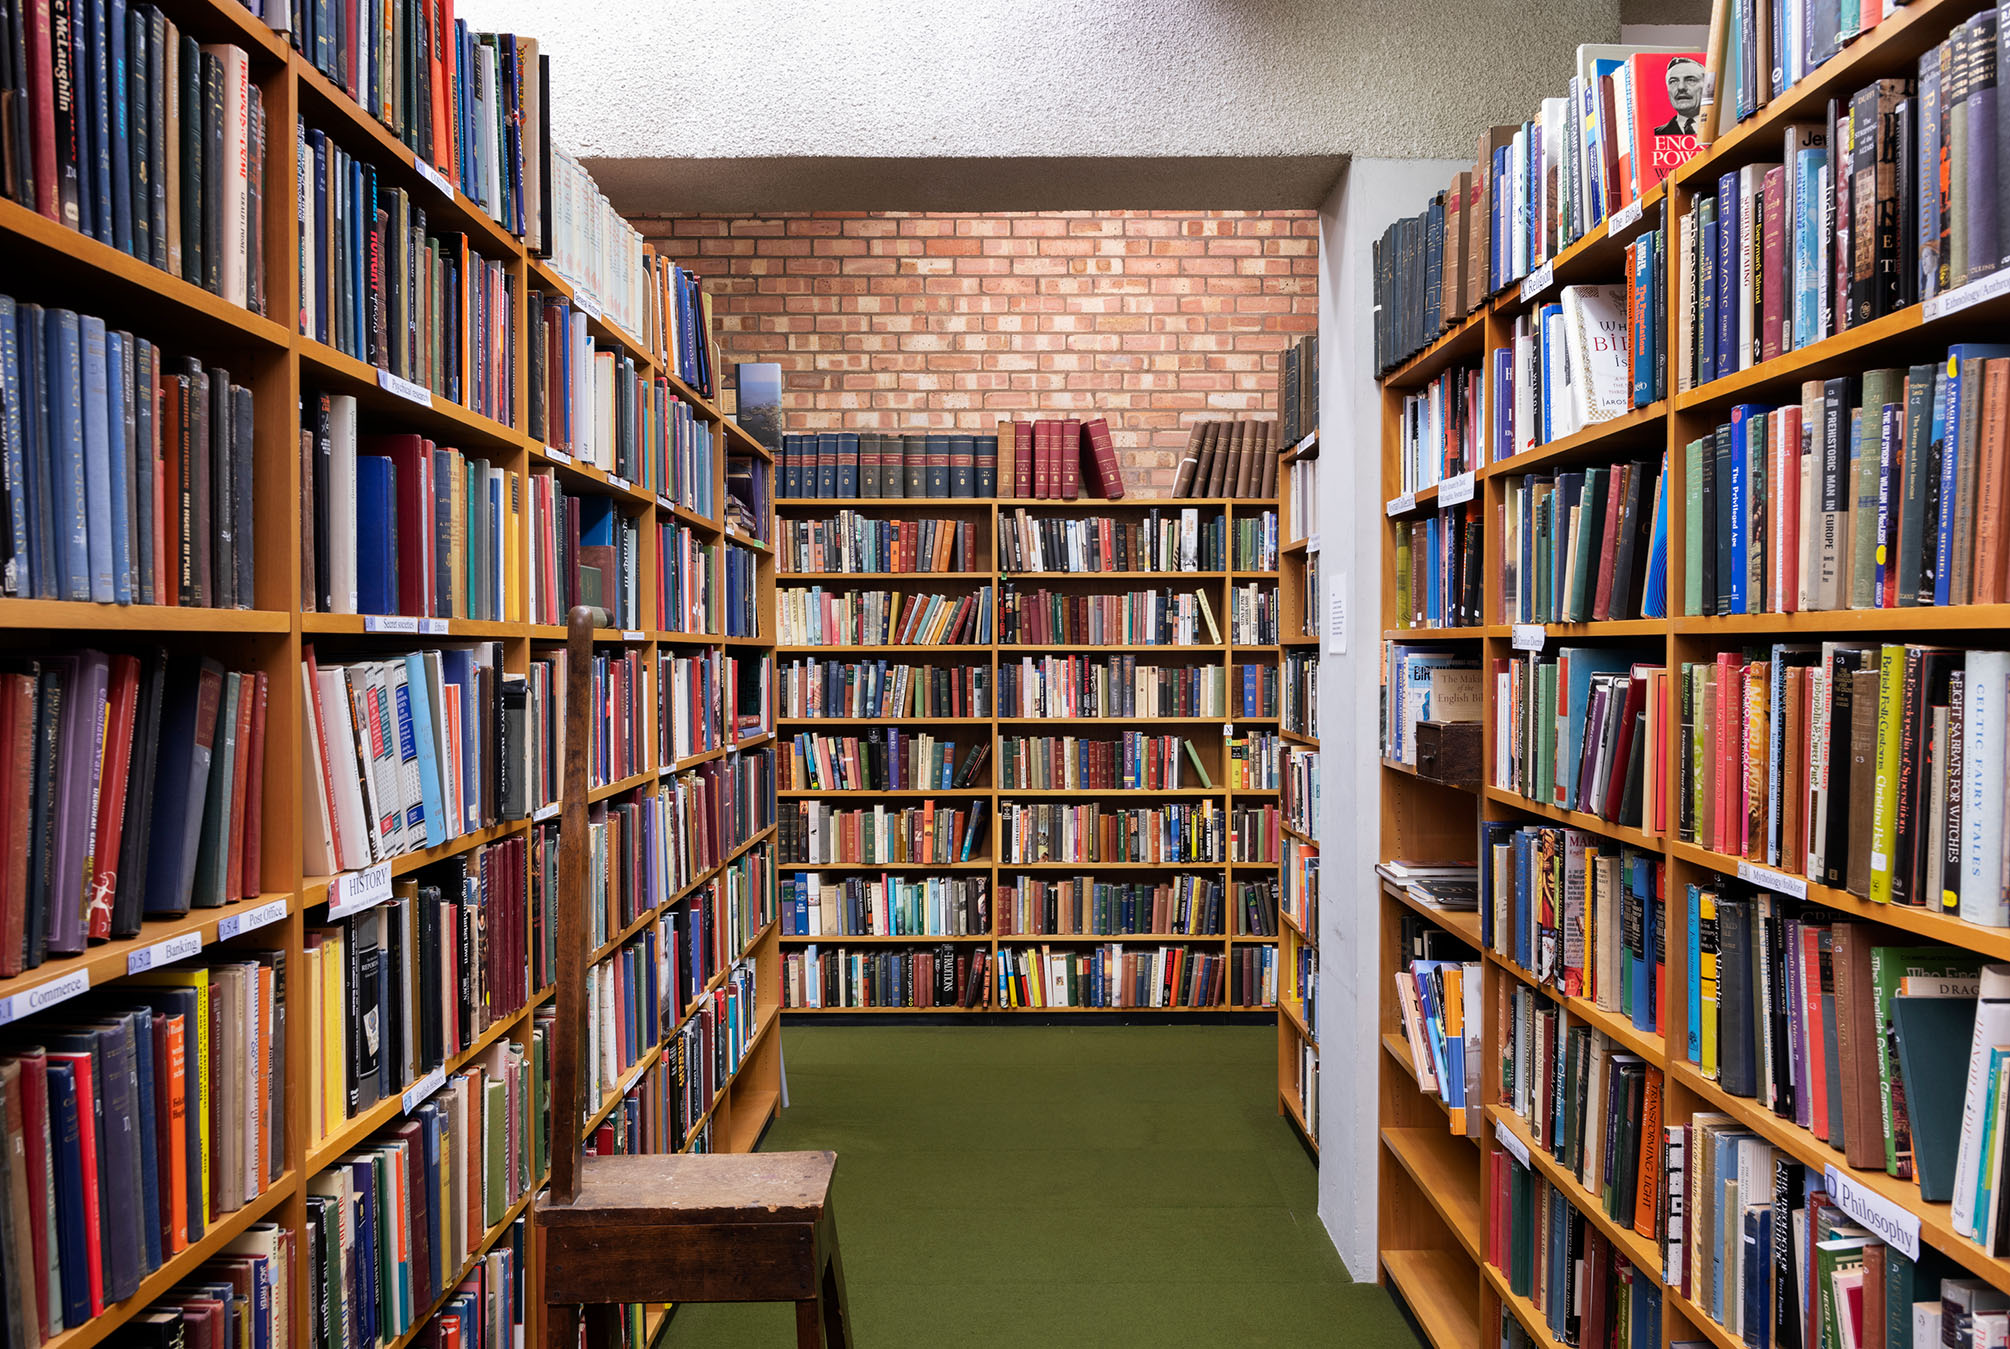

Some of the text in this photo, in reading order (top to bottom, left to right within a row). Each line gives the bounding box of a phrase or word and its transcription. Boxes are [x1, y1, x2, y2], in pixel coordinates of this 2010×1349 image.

[55, 16, 69, 112] McLaughlin
[1571, 125, 1579, 149] CAME
[1922, 90, 1936, 239] Reformation
[1572, 177, 1580, 210] ARABIA
[1611, 206, 1641, 231] The Bible
[1720, 179, 1729, 309] THE MORMONS
[1521, 273, 1552, 298] A Religion
[5, 328, 17, 368] THE
[1638, 303, 1647, 356] Foundations
[8, 375, 20, 454] MARKS
[1947, 393, 1957, 427] FRAGILE
[1945, 430, 1954, 480] PARADISE
[1825, 410, 1837, 549] PREHISTORIC MAN IN EUROPE
[15, 498, 27, 554] CAIN
[1731, 486, 1739, 532] Privileged
[1938, 532, 1947, 580] MITCHELL
[1443, 674, 1458, 684] The
[1825, 656, 1834, 680] King
[1881, 655, 1892, 693] British
[96, 688, 107, 747] Chocolate
[1438, 693, 1469, 704] English
[1824, 681, 1833, 712] Arthur
[1880, 694, 1890, 720] Folk
[93, 749, 102, 780] Wars
[1878, 721, 1888, 770] Customs
[1899, 679, 1915, 835] Encyclopedia Superstitions
[1821, 757, 1829, 791] Story
[1947, 679, 1964, 864] EIGHT SABBATS FOR WITCHES
[1971, 683, 1986, 877] CELTIC FAIRY TALES
[91, 787, 100, 829] DEBORAH
[1875, 775, 1887, 827] Christina
[349, 867, 389, 897] HISTORY
[249, 911, 263, 927] Post
[263, 904, 284, 921] Office
[166, 937, 199, 959] Banking
[29, 976, 82, 1009] Commerce
[1873, 983, 1883, 1033] English
[1877, 1037, 1888, 1078] Gypsy
[1556, 1063, 1565, 1117] Christians
[1880, 1082, 1890, 1139] Caravan
[1641, 1084, 1659, 1210] TRANSFORMING LIGHT
[1826, 1175, 1914, 1254] D Philosophy
[259, 1266, 267, 1283] JACK
